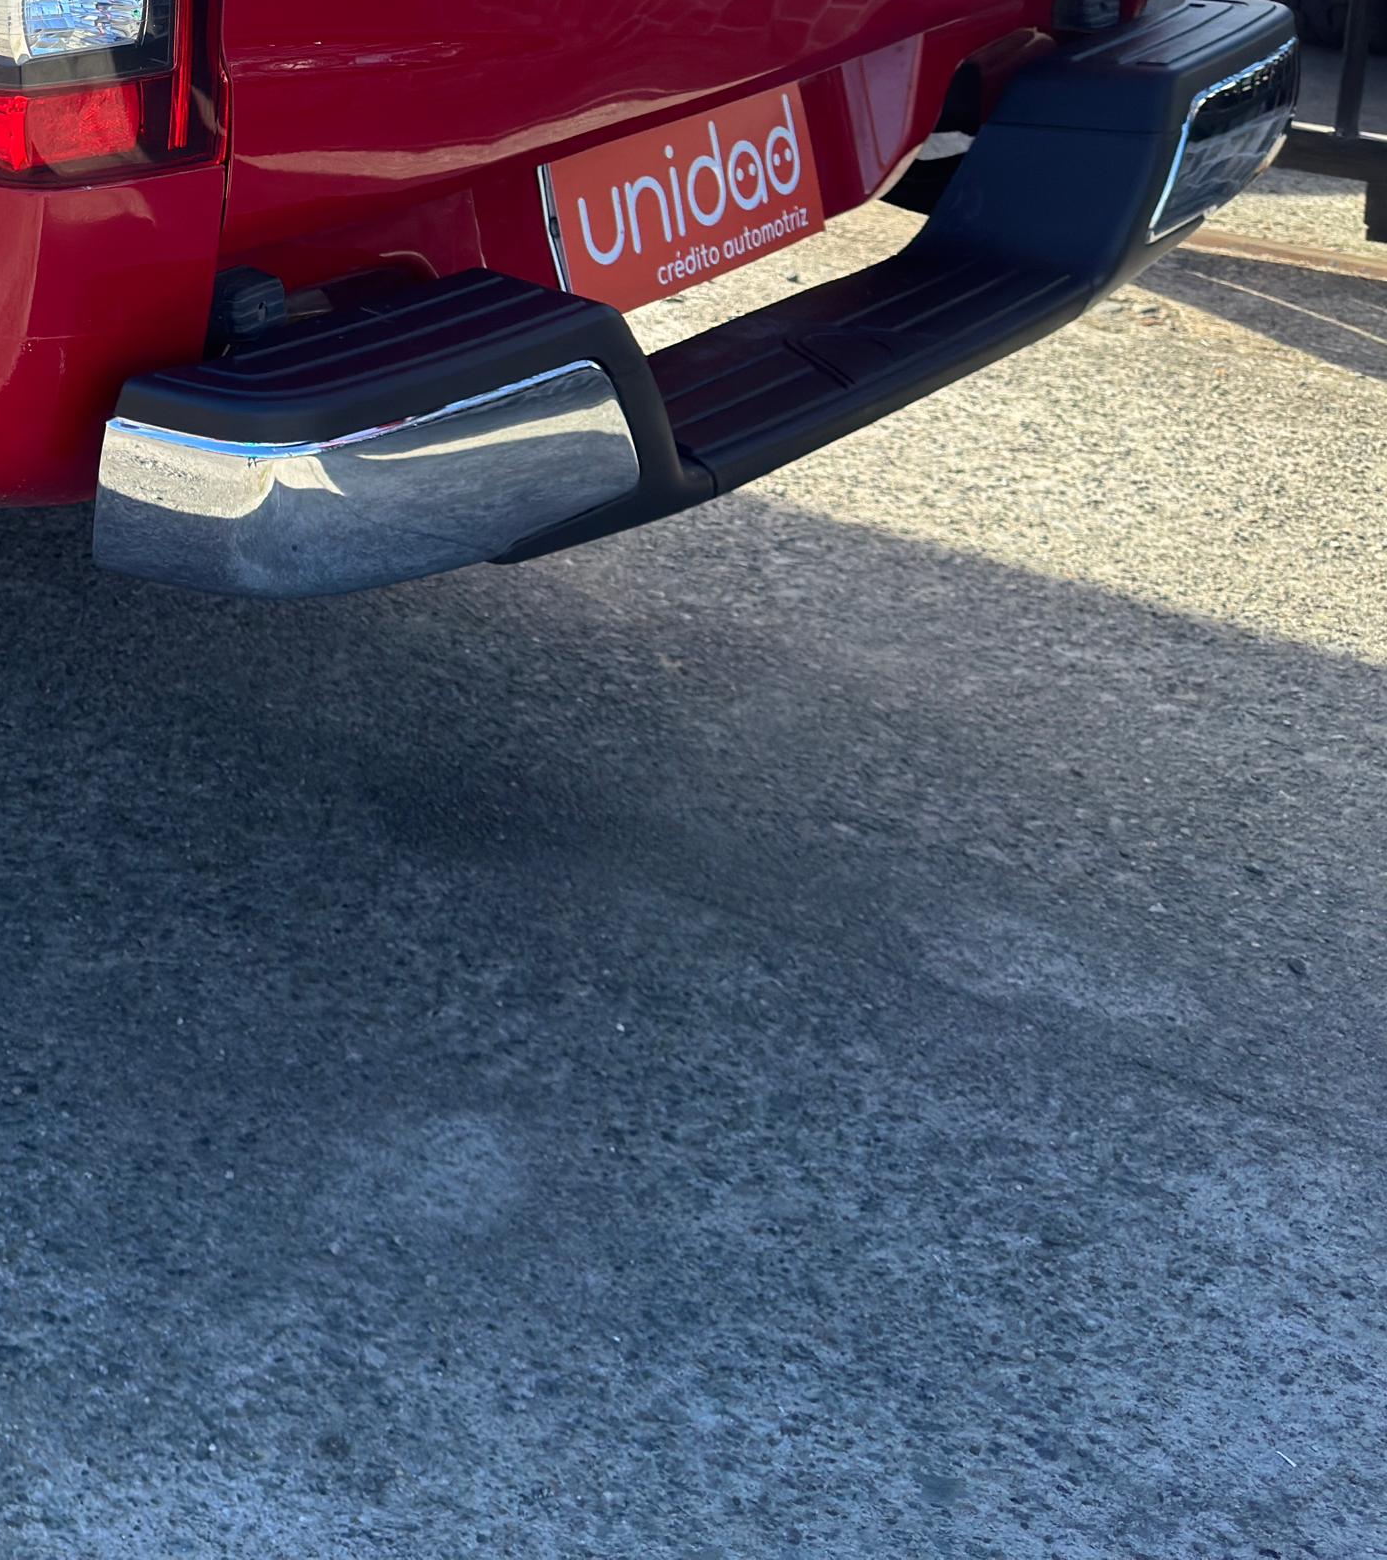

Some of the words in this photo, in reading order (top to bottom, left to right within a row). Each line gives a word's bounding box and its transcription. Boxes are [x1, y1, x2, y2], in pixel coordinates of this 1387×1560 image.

[577, 93, 801, 265] unidad
[657, 243, 720, 286] crédito
[723, 205, 809, 260] automotriz
